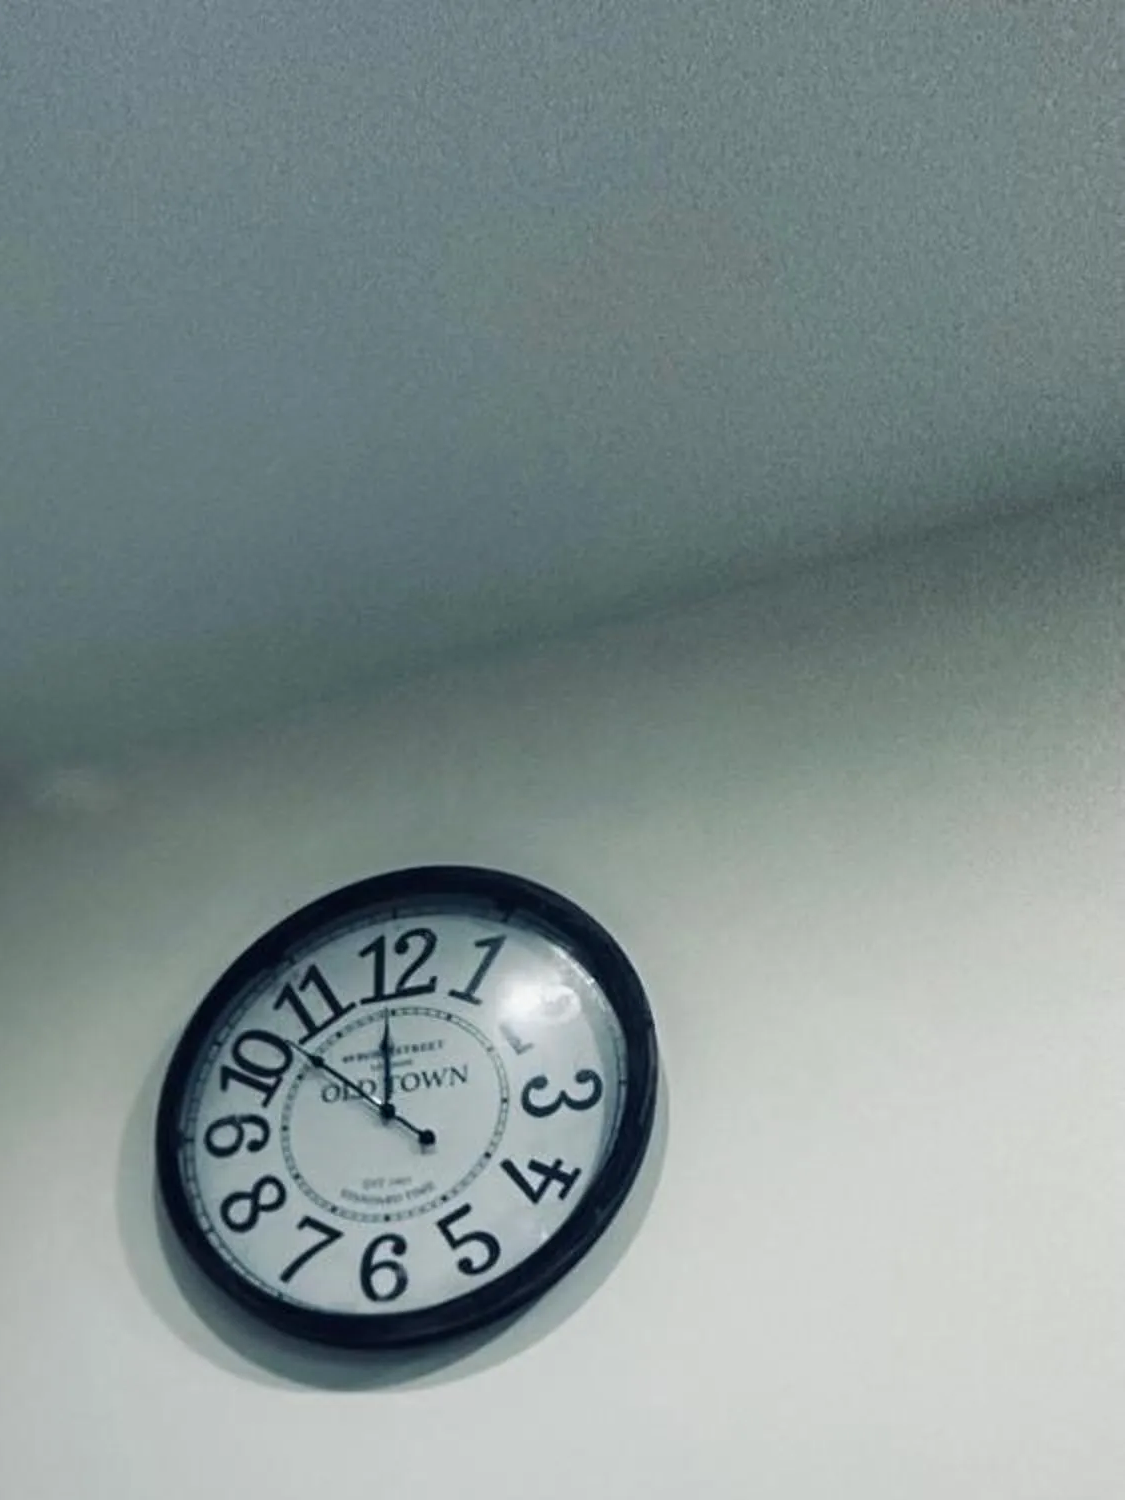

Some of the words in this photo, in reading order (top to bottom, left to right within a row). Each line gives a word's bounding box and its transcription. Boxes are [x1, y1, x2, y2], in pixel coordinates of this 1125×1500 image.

[358, 927, 438, 1005] 12
[448, 935, 507, 1005] 1
[273, 964, 358, 1046] 11
[219, 1028, 295, 1109] 10
[521, 1069, 603, 1118] 3
[203, 1113, 271, 1159] 9
[219, 1175, 288, 1233] 8
[500, 1155, 583, 1205] 4
[280, 1216, 345, 1284] 7
[359, 1233, 409, 1303] 6
[437, 1203, 502, 1276] 5
